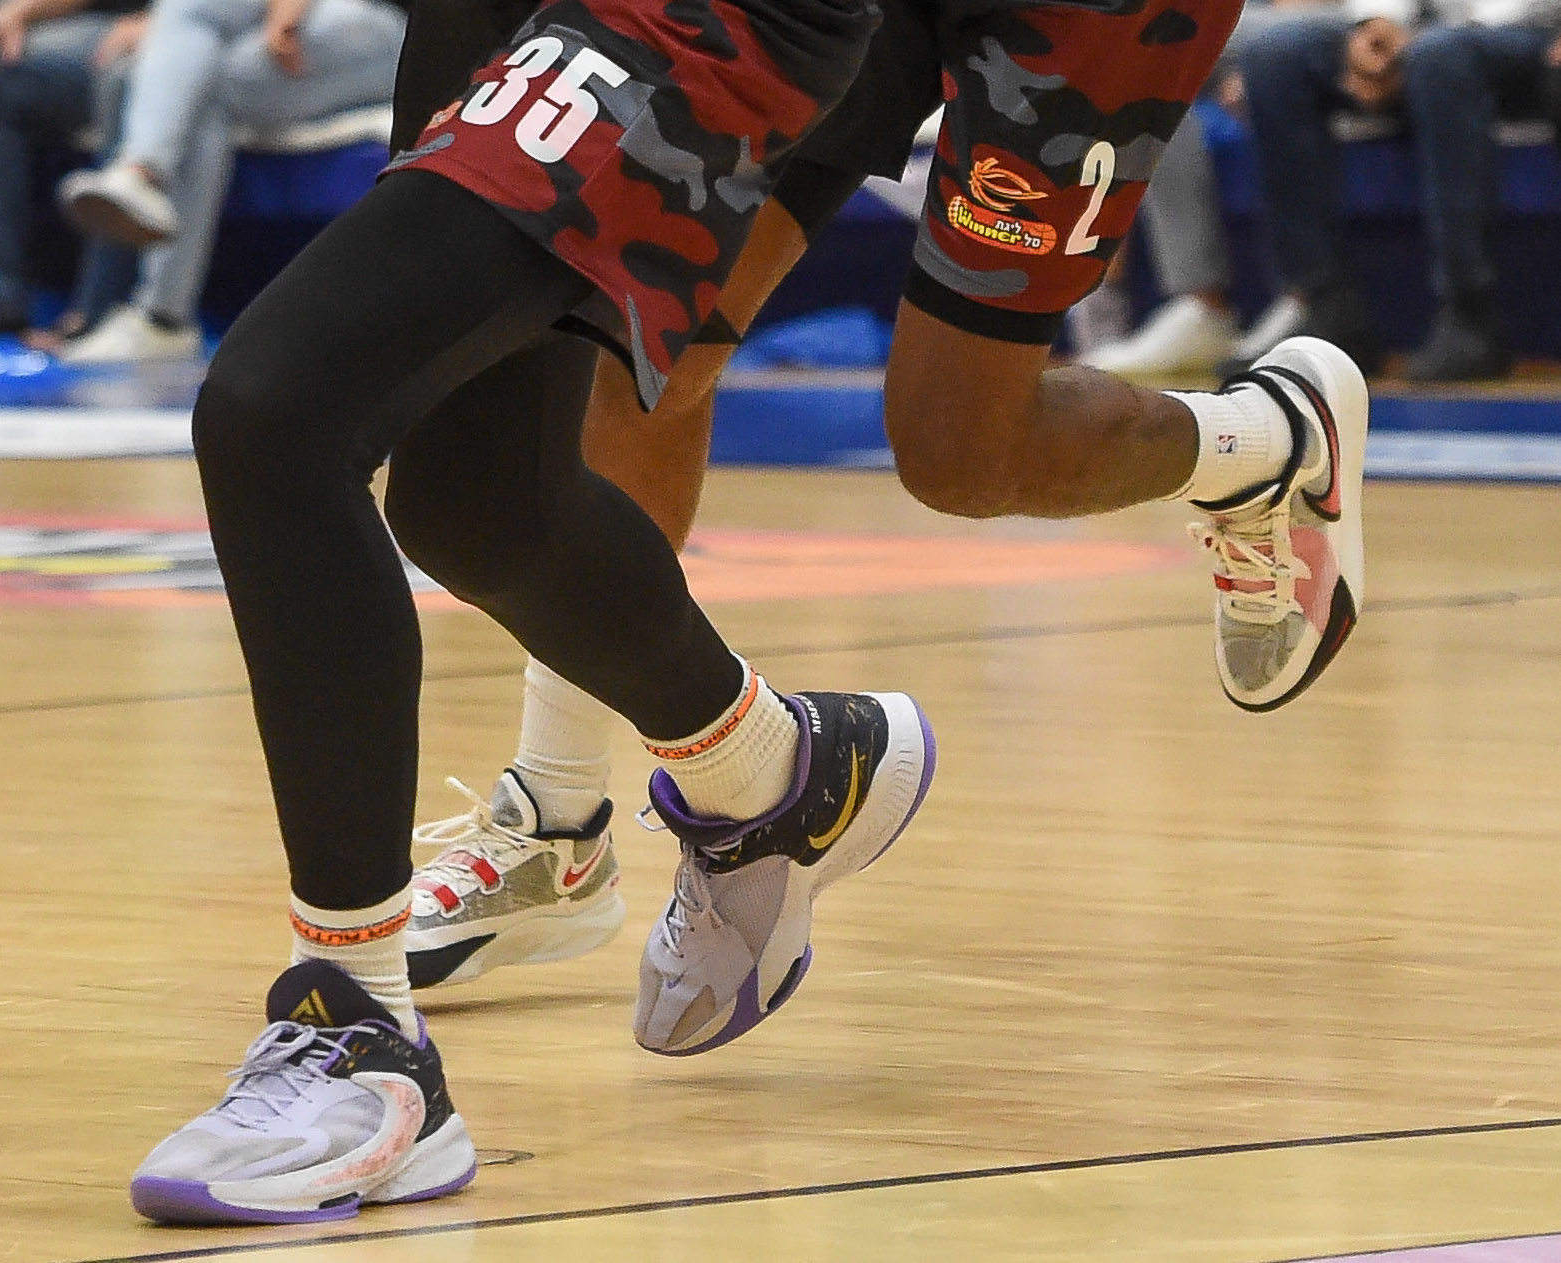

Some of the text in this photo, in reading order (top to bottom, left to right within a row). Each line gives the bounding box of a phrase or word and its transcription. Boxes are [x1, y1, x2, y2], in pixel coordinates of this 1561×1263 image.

[460, 36, 631, 164] 35
[957, 205, 1042, 248] Winner סל
[995, 220, 1022, 234] ליגת
[1064, 141, 1116, 256] 2
